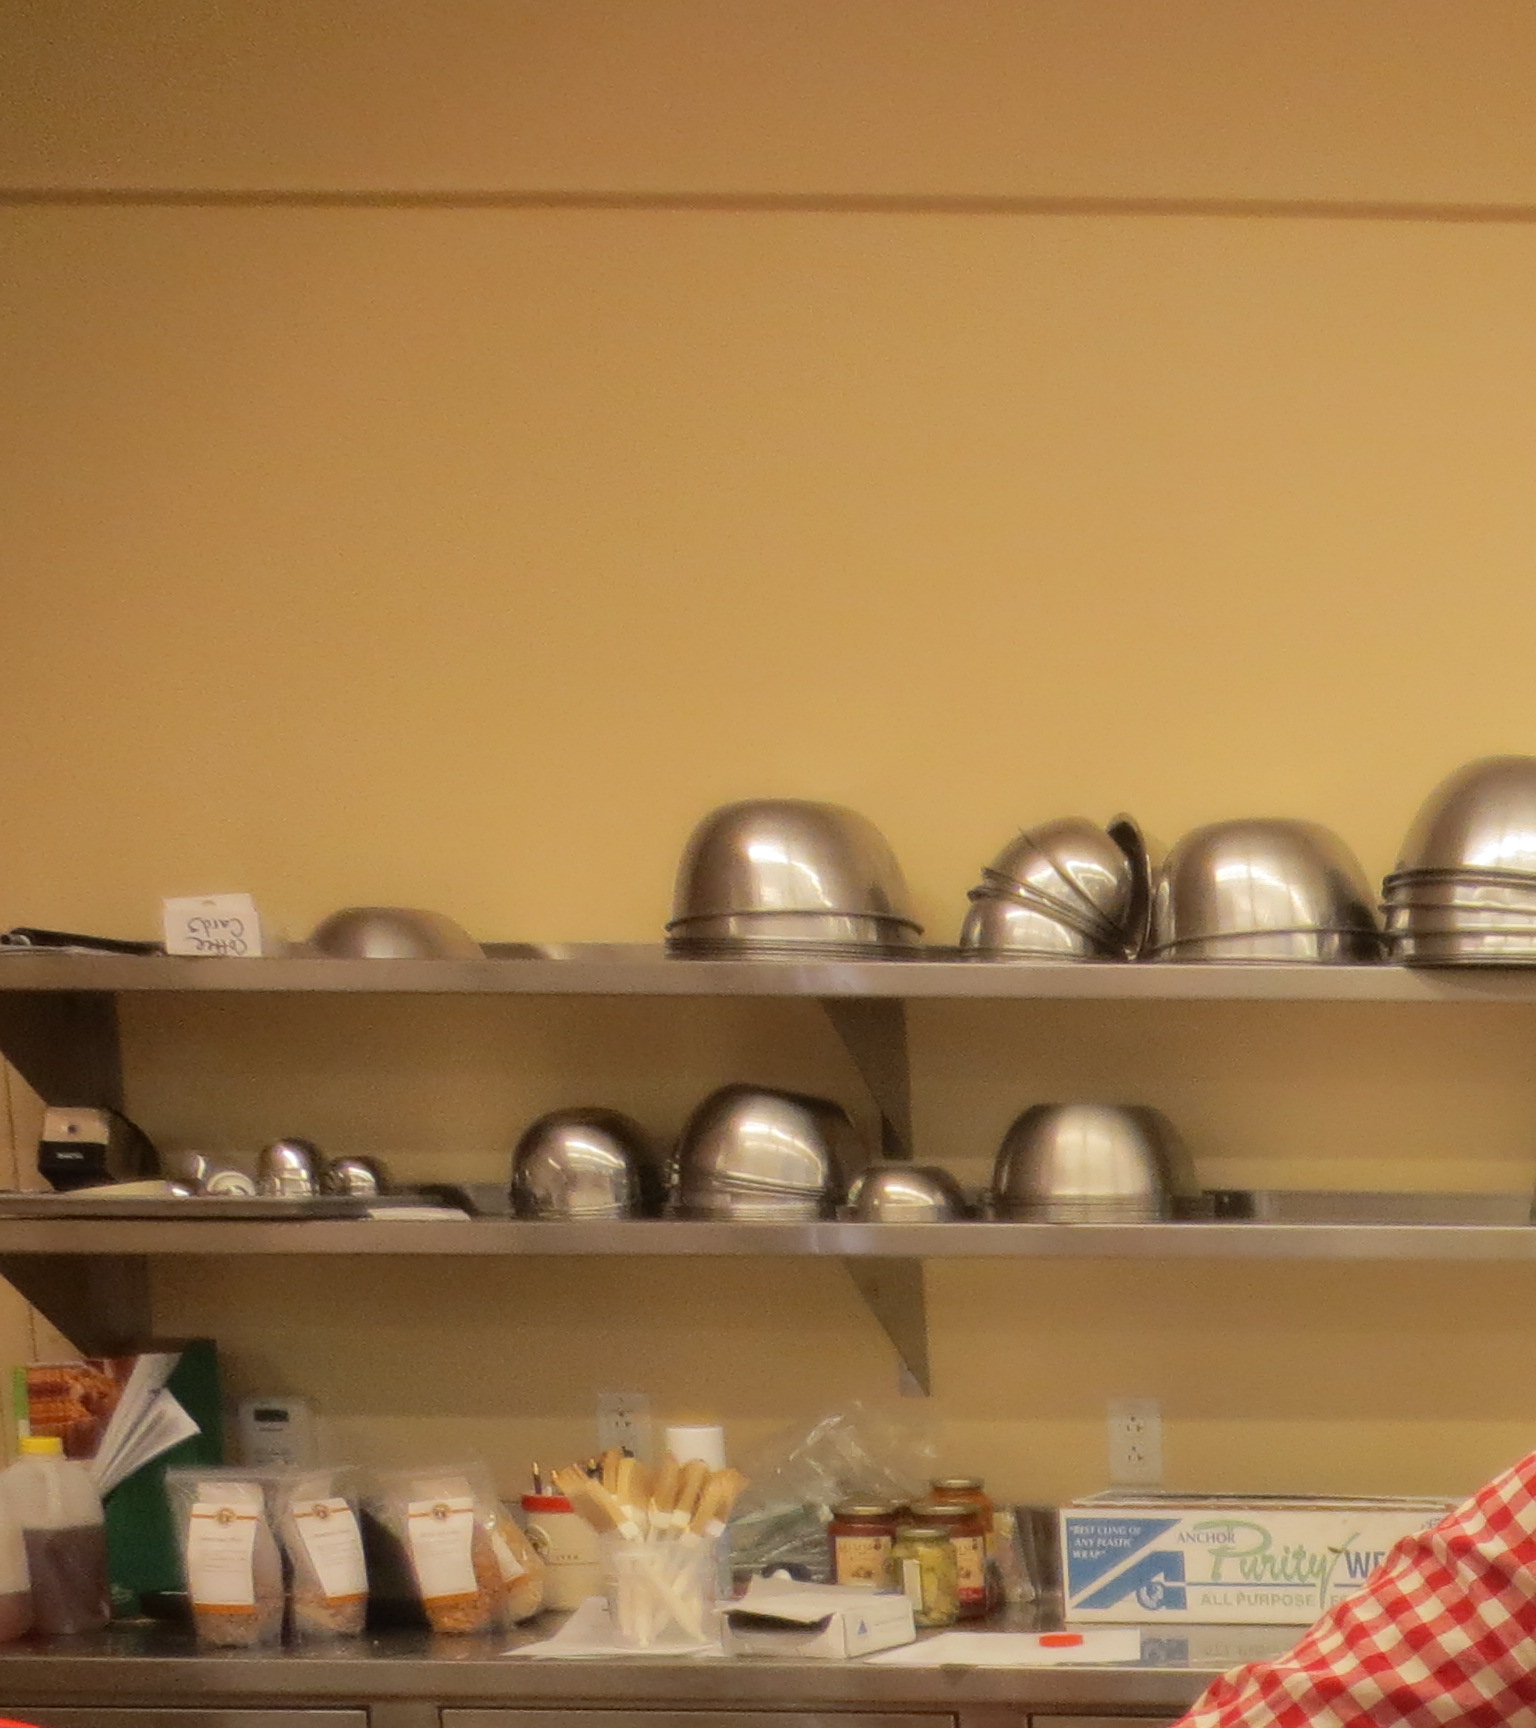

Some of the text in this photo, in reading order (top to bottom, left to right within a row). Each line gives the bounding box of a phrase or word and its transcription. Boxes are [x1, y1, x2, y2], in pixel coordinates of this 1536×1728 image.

[187, 917, 245, 937] Cards
[1176, 1531, 1236, 1544] ANCHOR
[1193, 1519, 1360, 1609] Purity
[1200, 1593, 1234, 1606] ALL
[1236, 1592, 1317, 1607] PURPOSE
